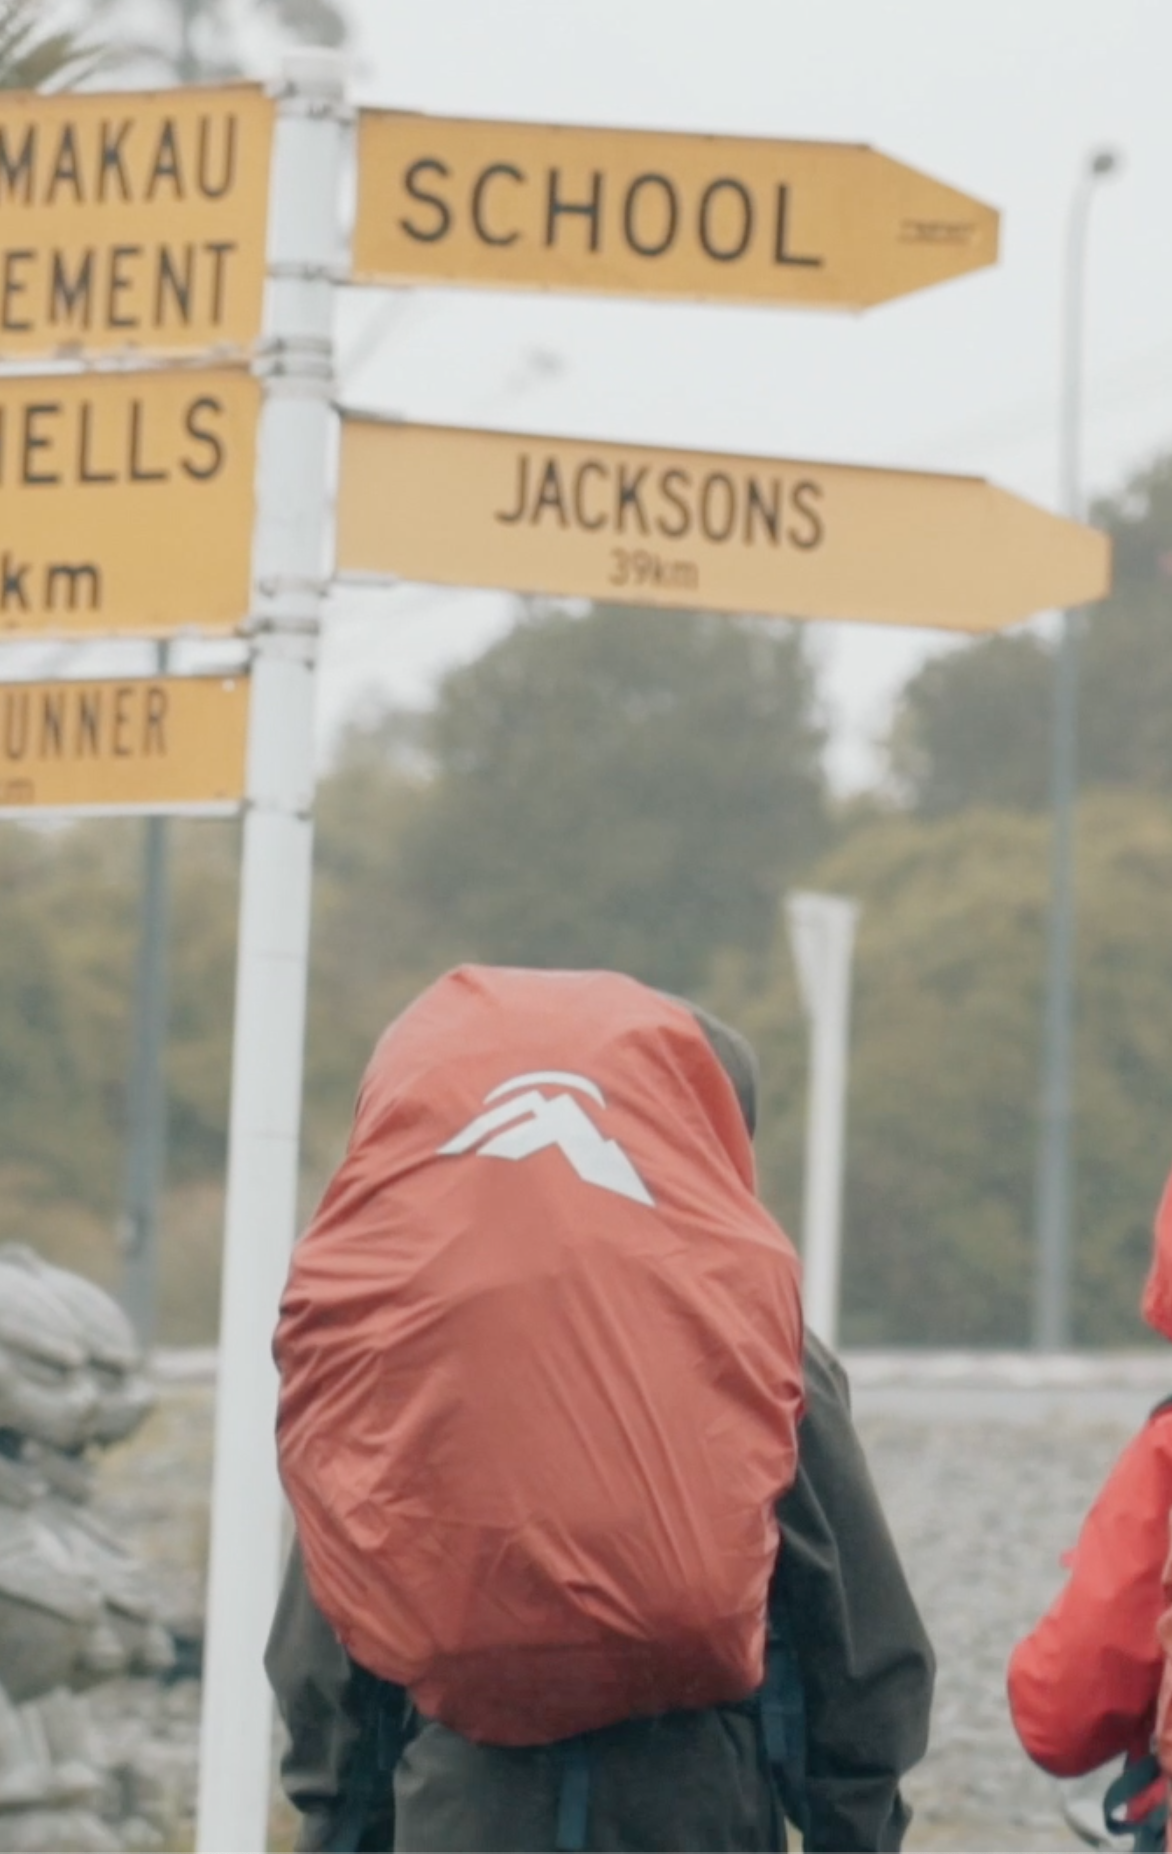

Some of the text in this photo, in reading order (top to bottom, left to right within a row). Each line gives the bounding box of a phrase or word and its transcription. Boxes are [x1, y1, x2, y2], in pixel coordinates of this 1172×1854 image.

[399, 157, 824, 269] SCHOOL
[1, 241, 236, 330] EMENT
[0, 397, 225, 486] ELLS
[495, 452, 825, 551] JACKSONS
[1, 549, 102, 614] km
[608, 547, 699, 590] 39km
[5, 685, 170, 763] UNNER
